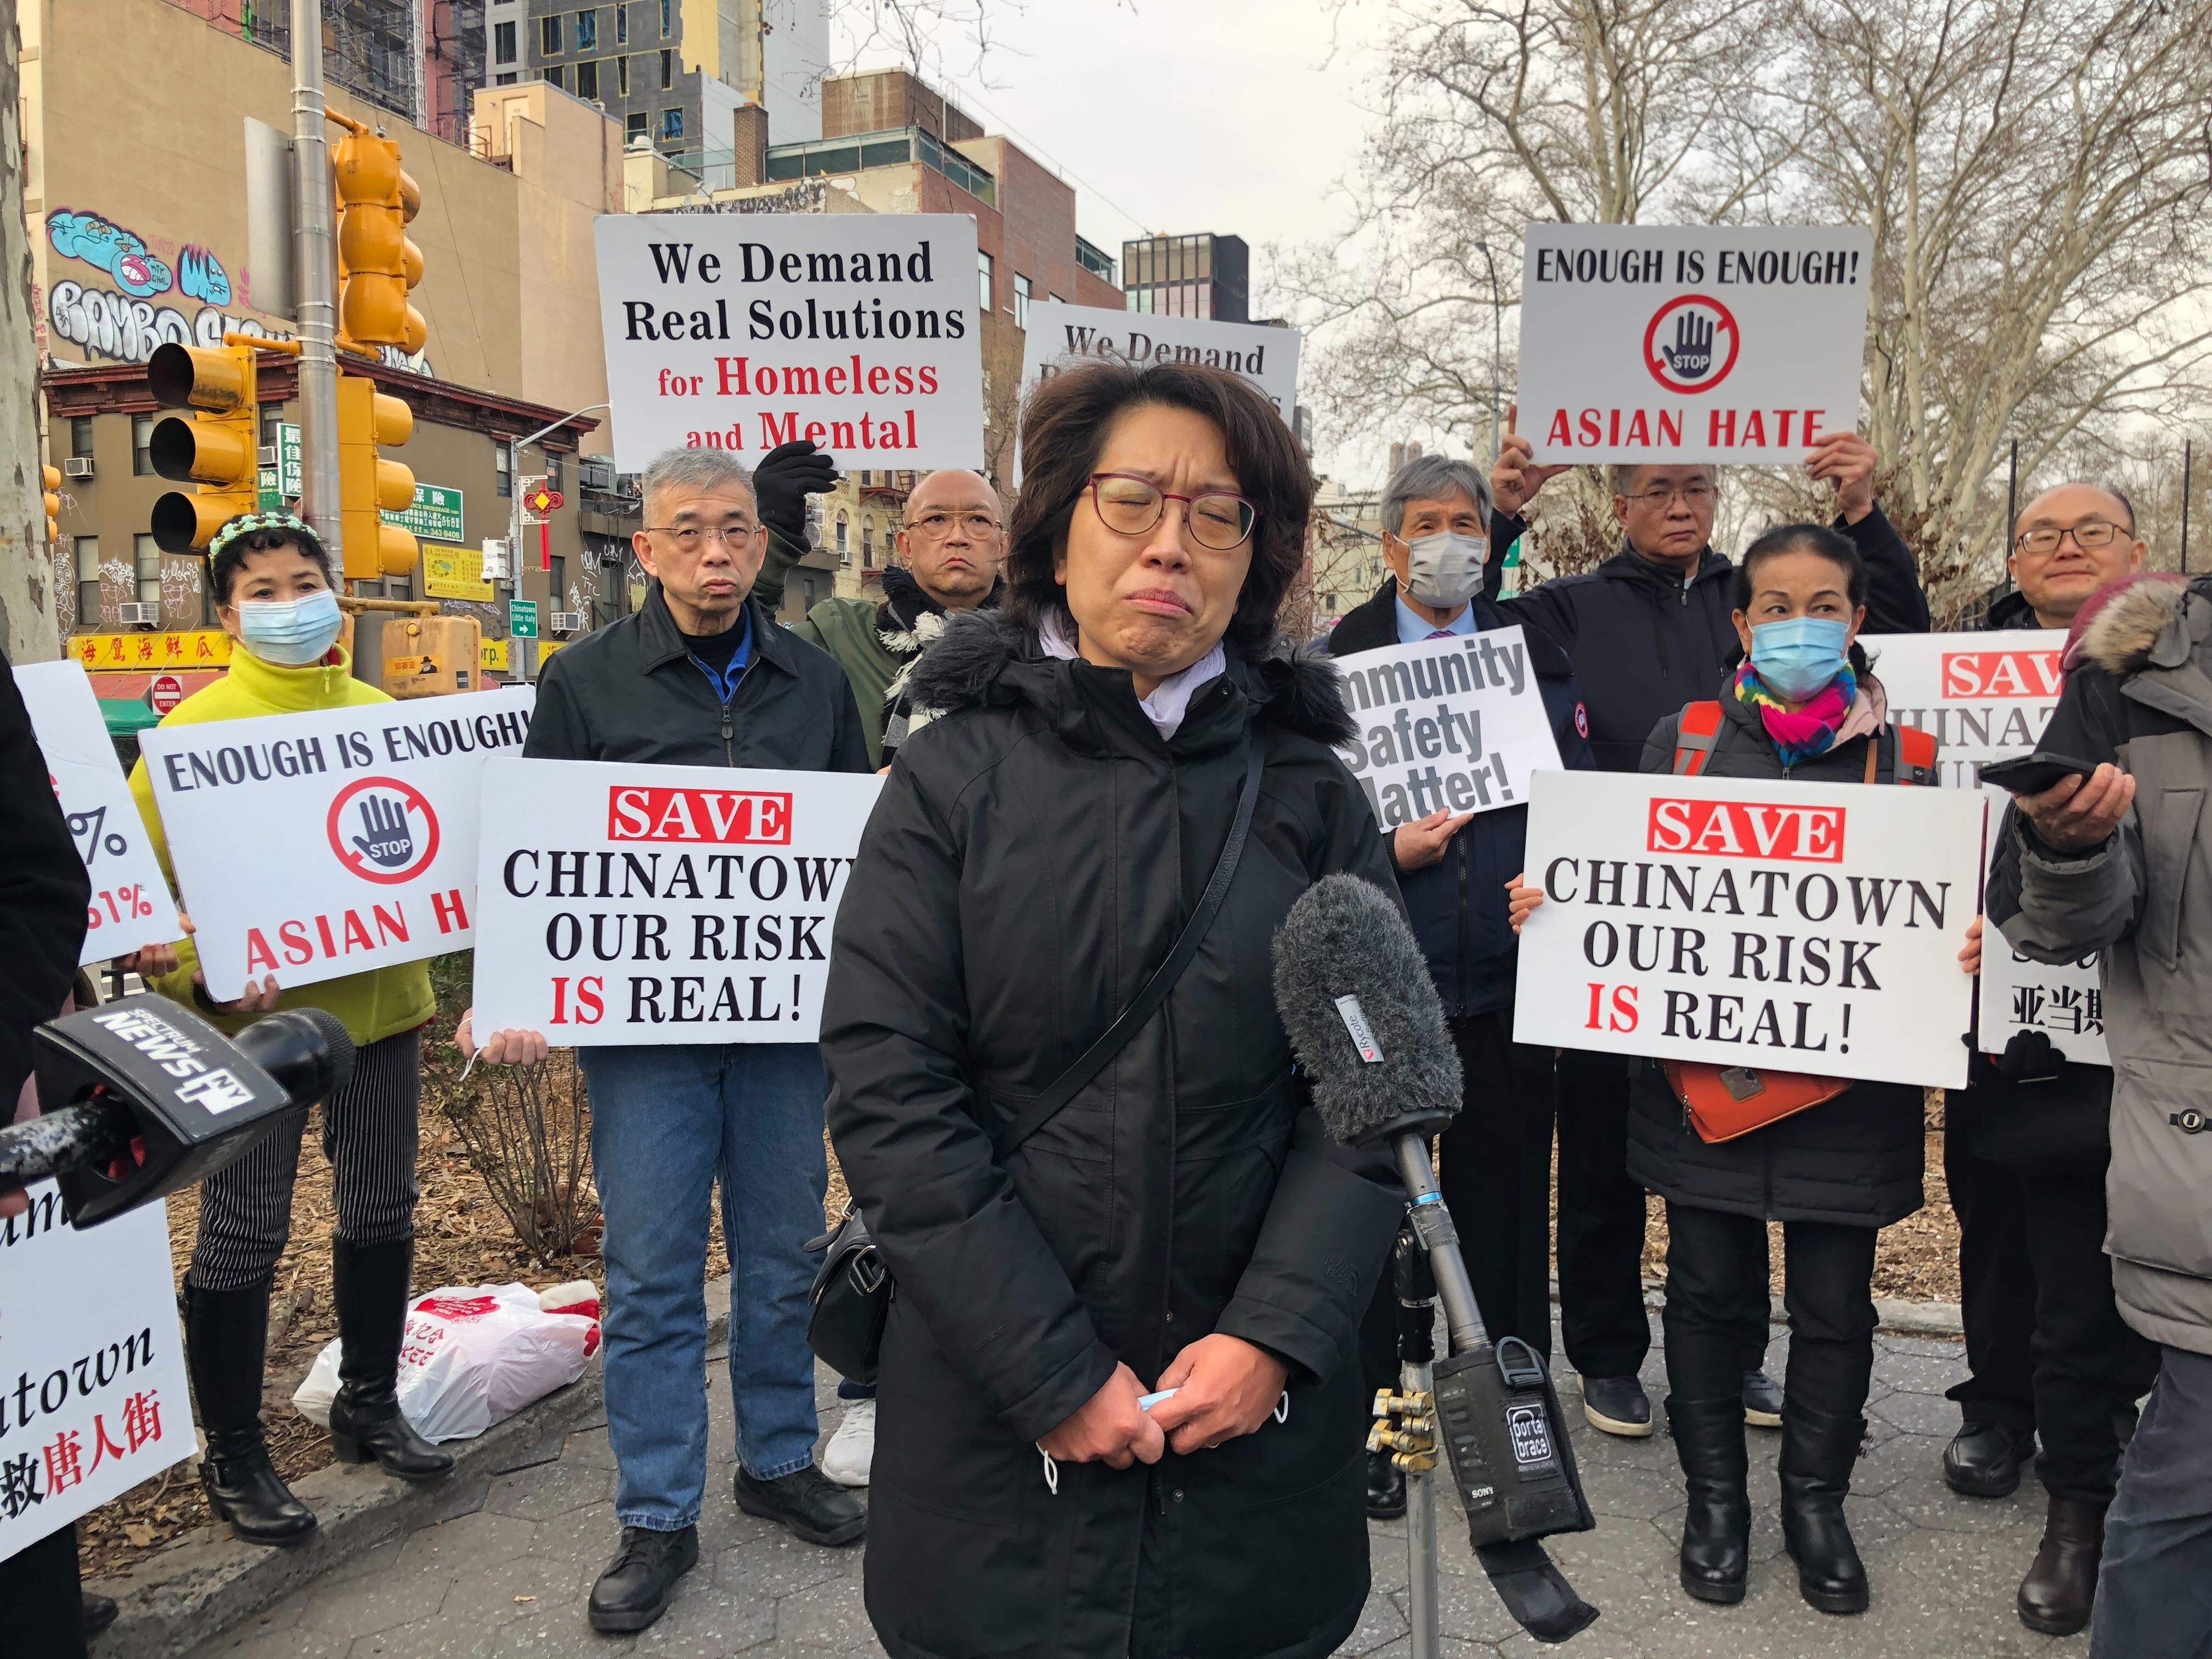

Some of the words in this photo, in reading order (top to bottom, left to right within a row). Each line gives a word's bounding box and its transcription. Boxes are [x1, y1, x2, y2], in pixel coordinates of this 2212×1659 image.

[648, 243, 721, 285] We
[740, 241, 934, 283] Demand
[1536, 249, 1663, 283] ENOUGH
[1675, 250, 1705, 283] IS
[1717, 250, 1859, 285] ENOUGH!
[622, 300, 731, 341] Real
[748, 298, 966, 340] Solutions
[1064, 325, 1113, 358] We
[1128, 331, 1264, 375] Demand
[1672, 354, 1709, 370] STOP
[658, 369, 704, 396] for
[714, 355, 939, 396] Homeless
[686, 423, 744, 451] and
[757, 409, 918, 450] Mental
[1546, 408, 1683, 448] ASIAN
[1707, 409, 1826, 448] HATE
[511, 605, 535, 613] Chinatown
[512, 613, 524, 622] Little
[524, 614, 535, 624] Italy
[481, 647, 499, 665] rp.
[1338, 638, 1525, 712] mmunity
[1949, 653, 2062, 697] SAV
[159, 699, 176, 708] ENTER
[163, 737, 327, 792] ENOUGH
[336, 731, 374, 769] IS
[614, 790, 786, 842] SAVE
[1654, 801, 1837, 859] SAVE
[369, 839, 411, 857] STOP
[503, 849, 856, 902] CHINATOW
[1544, 856, 1952, 930] CHINATOWN
[247, 901, 409, 974] ASIAN
[546, 912, 671, 961] OUR
[690, 915, 826, 961] RISK
[1583, 920, 1708, 977] OUR
[1729, 931, 1882, 990] RISK
[550, 975, 604, 1025] IS
[626, 974, 802, 1024] REAL!
[1584, 983, 1639, 1033] IS
[1661, 990, 1852, 1054] REAL!
[92, 1012, 207, 1078] NEWS
[127, 1008, 201, 1053] SPECTRUM
[1349, 1014, 1370, 1049] Rycote
[0, 1389, 162, 1521] 救唐人街
[1471, 1486, 1494, 1499] SONY
